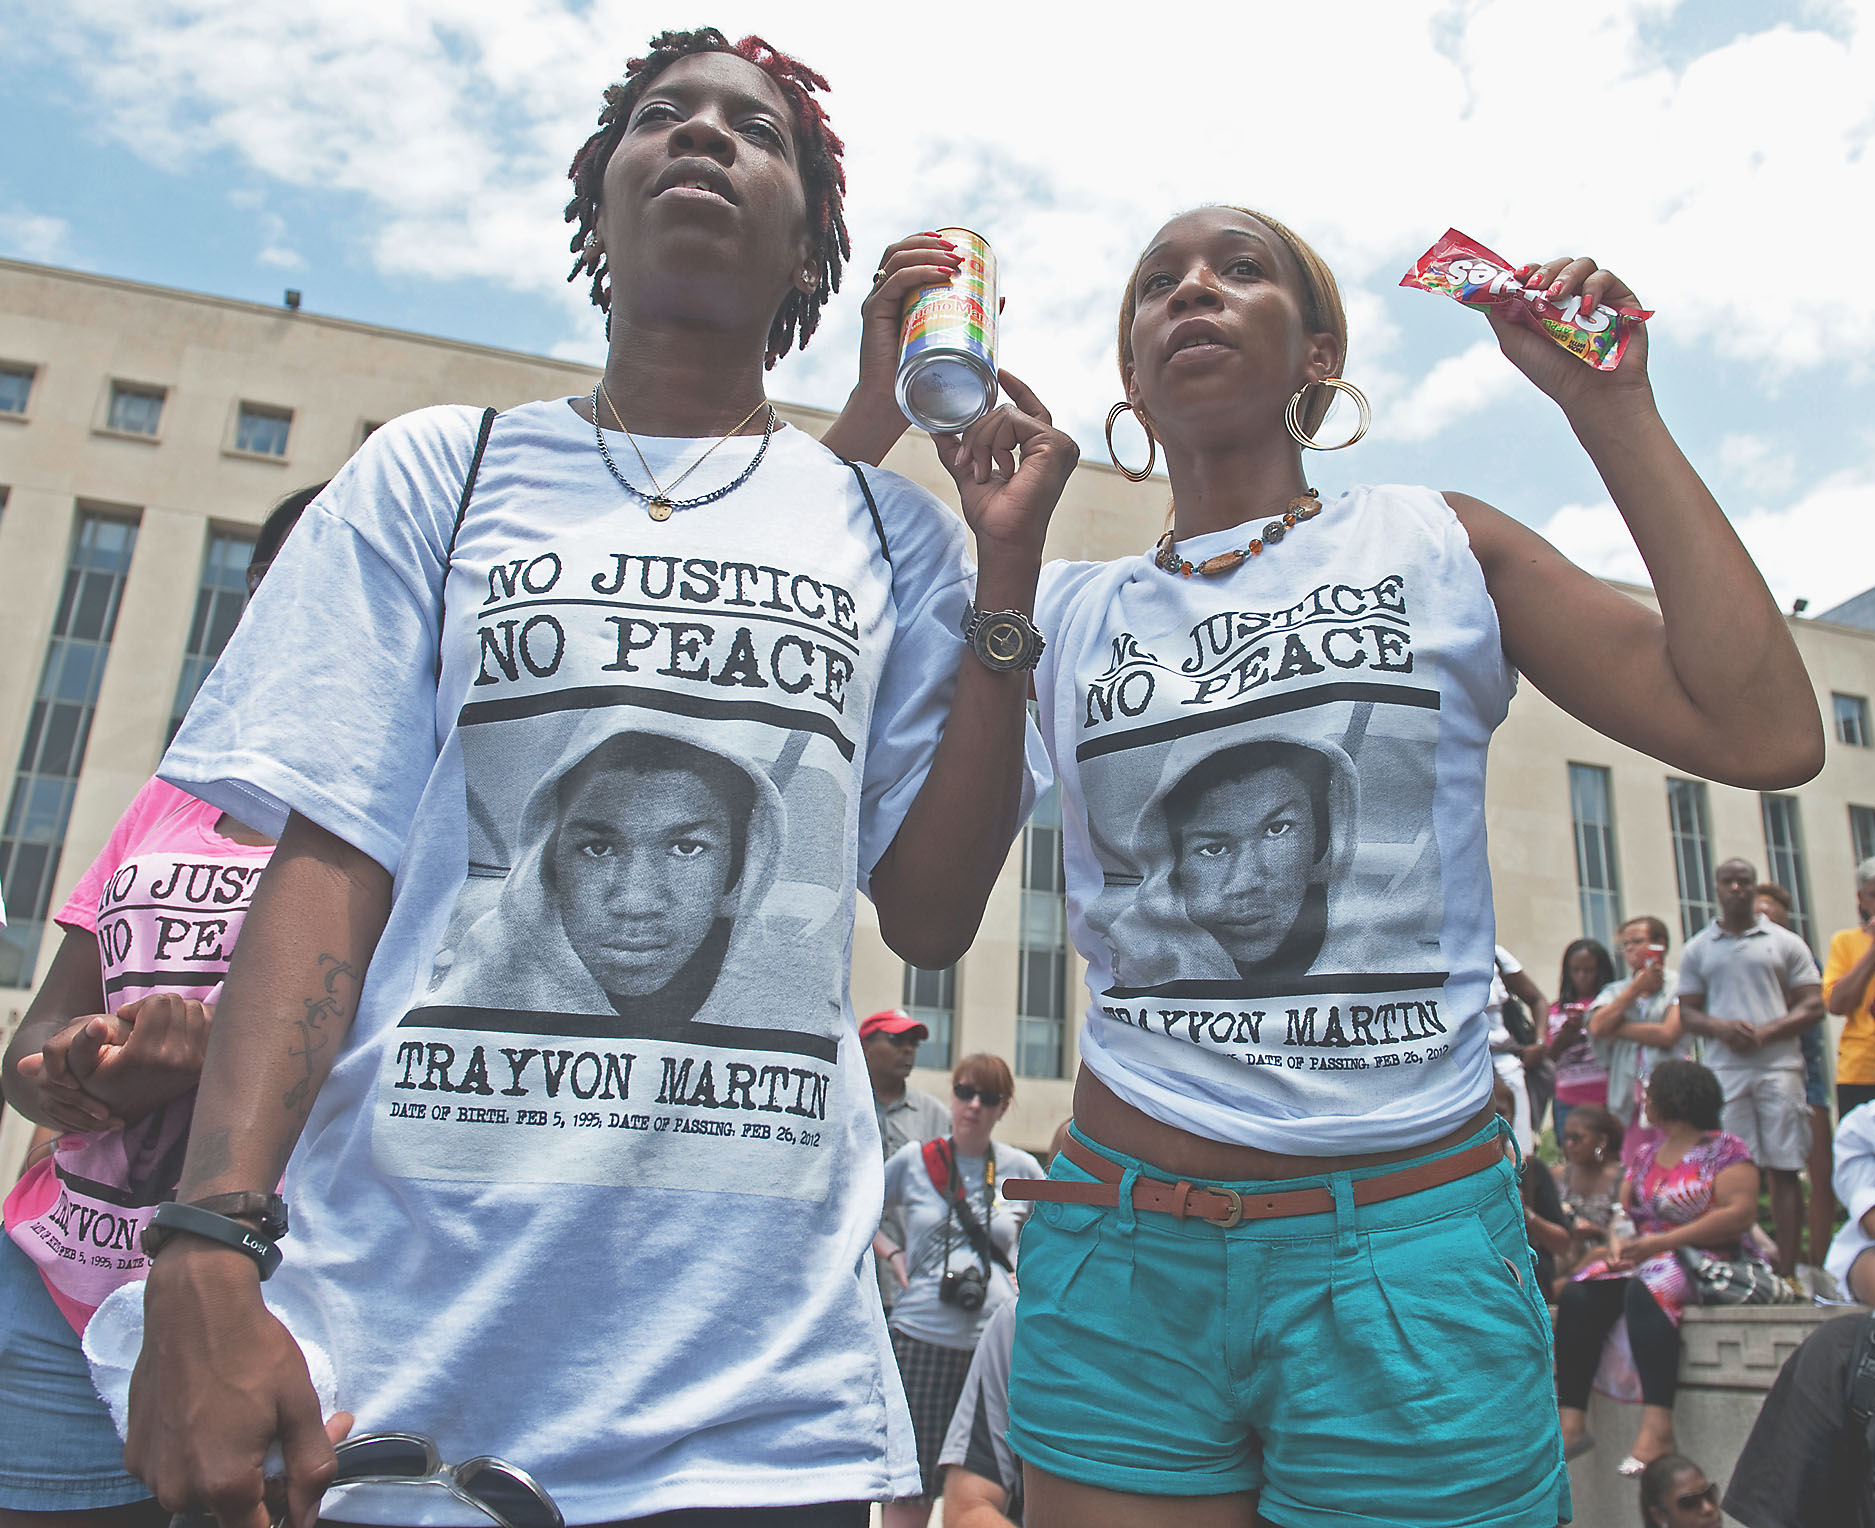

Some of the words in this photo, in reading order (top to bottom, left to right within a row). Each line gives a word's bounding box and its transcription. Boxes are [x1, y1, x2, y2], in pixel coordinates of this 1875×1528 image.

[483, 552, 562, 605] NO
[592, 553, 860, 640] JUSTICE
[1181, 574, 1407, 673] JUSTICE
[473, 614, 565, 687] NO
[601, 616, 855, 714] PEACE
[1084, 670, 1155, 729] NO
[1181, 624, 1414, 705] PEACE
[99, 864, 138, 912] NO
[99, 918, 133, 967] NO
[154, 916, 233, 961] PE
[1283, 1000, 1447, 1048] MARTIN
[394, 1040, 637, 1101] TRAYVON
[655, 1056, 830, 1120] MARTIN
[1245, 1053, 1283, 1067] DATE
[1287, 1056, 1304, 1069] OF
[1374, 1053, 1400, 1069] FEB
[1403, 1051, 1423, 1065] 26,
[1426, 1044, 1449, 1061] 2012
[389, 1102, 427, 1119] DATE
[431, 1105, 451, 1121] OF
[515, 1109, 548, 1126] FEB
[552, 1111, 566, 1128] 5,
[608, 1113, 650, 1130] DATE
[654, 1117, 670, 1132] OF
[741, 1123, 771, 1139] FEB
[776, 1126, 797, 1145] 26,
[800, 1130, 821, 1147] 2012
[116, 1257, 145, 1270] DATE
[242, 1233, 267, 1256] Lost
